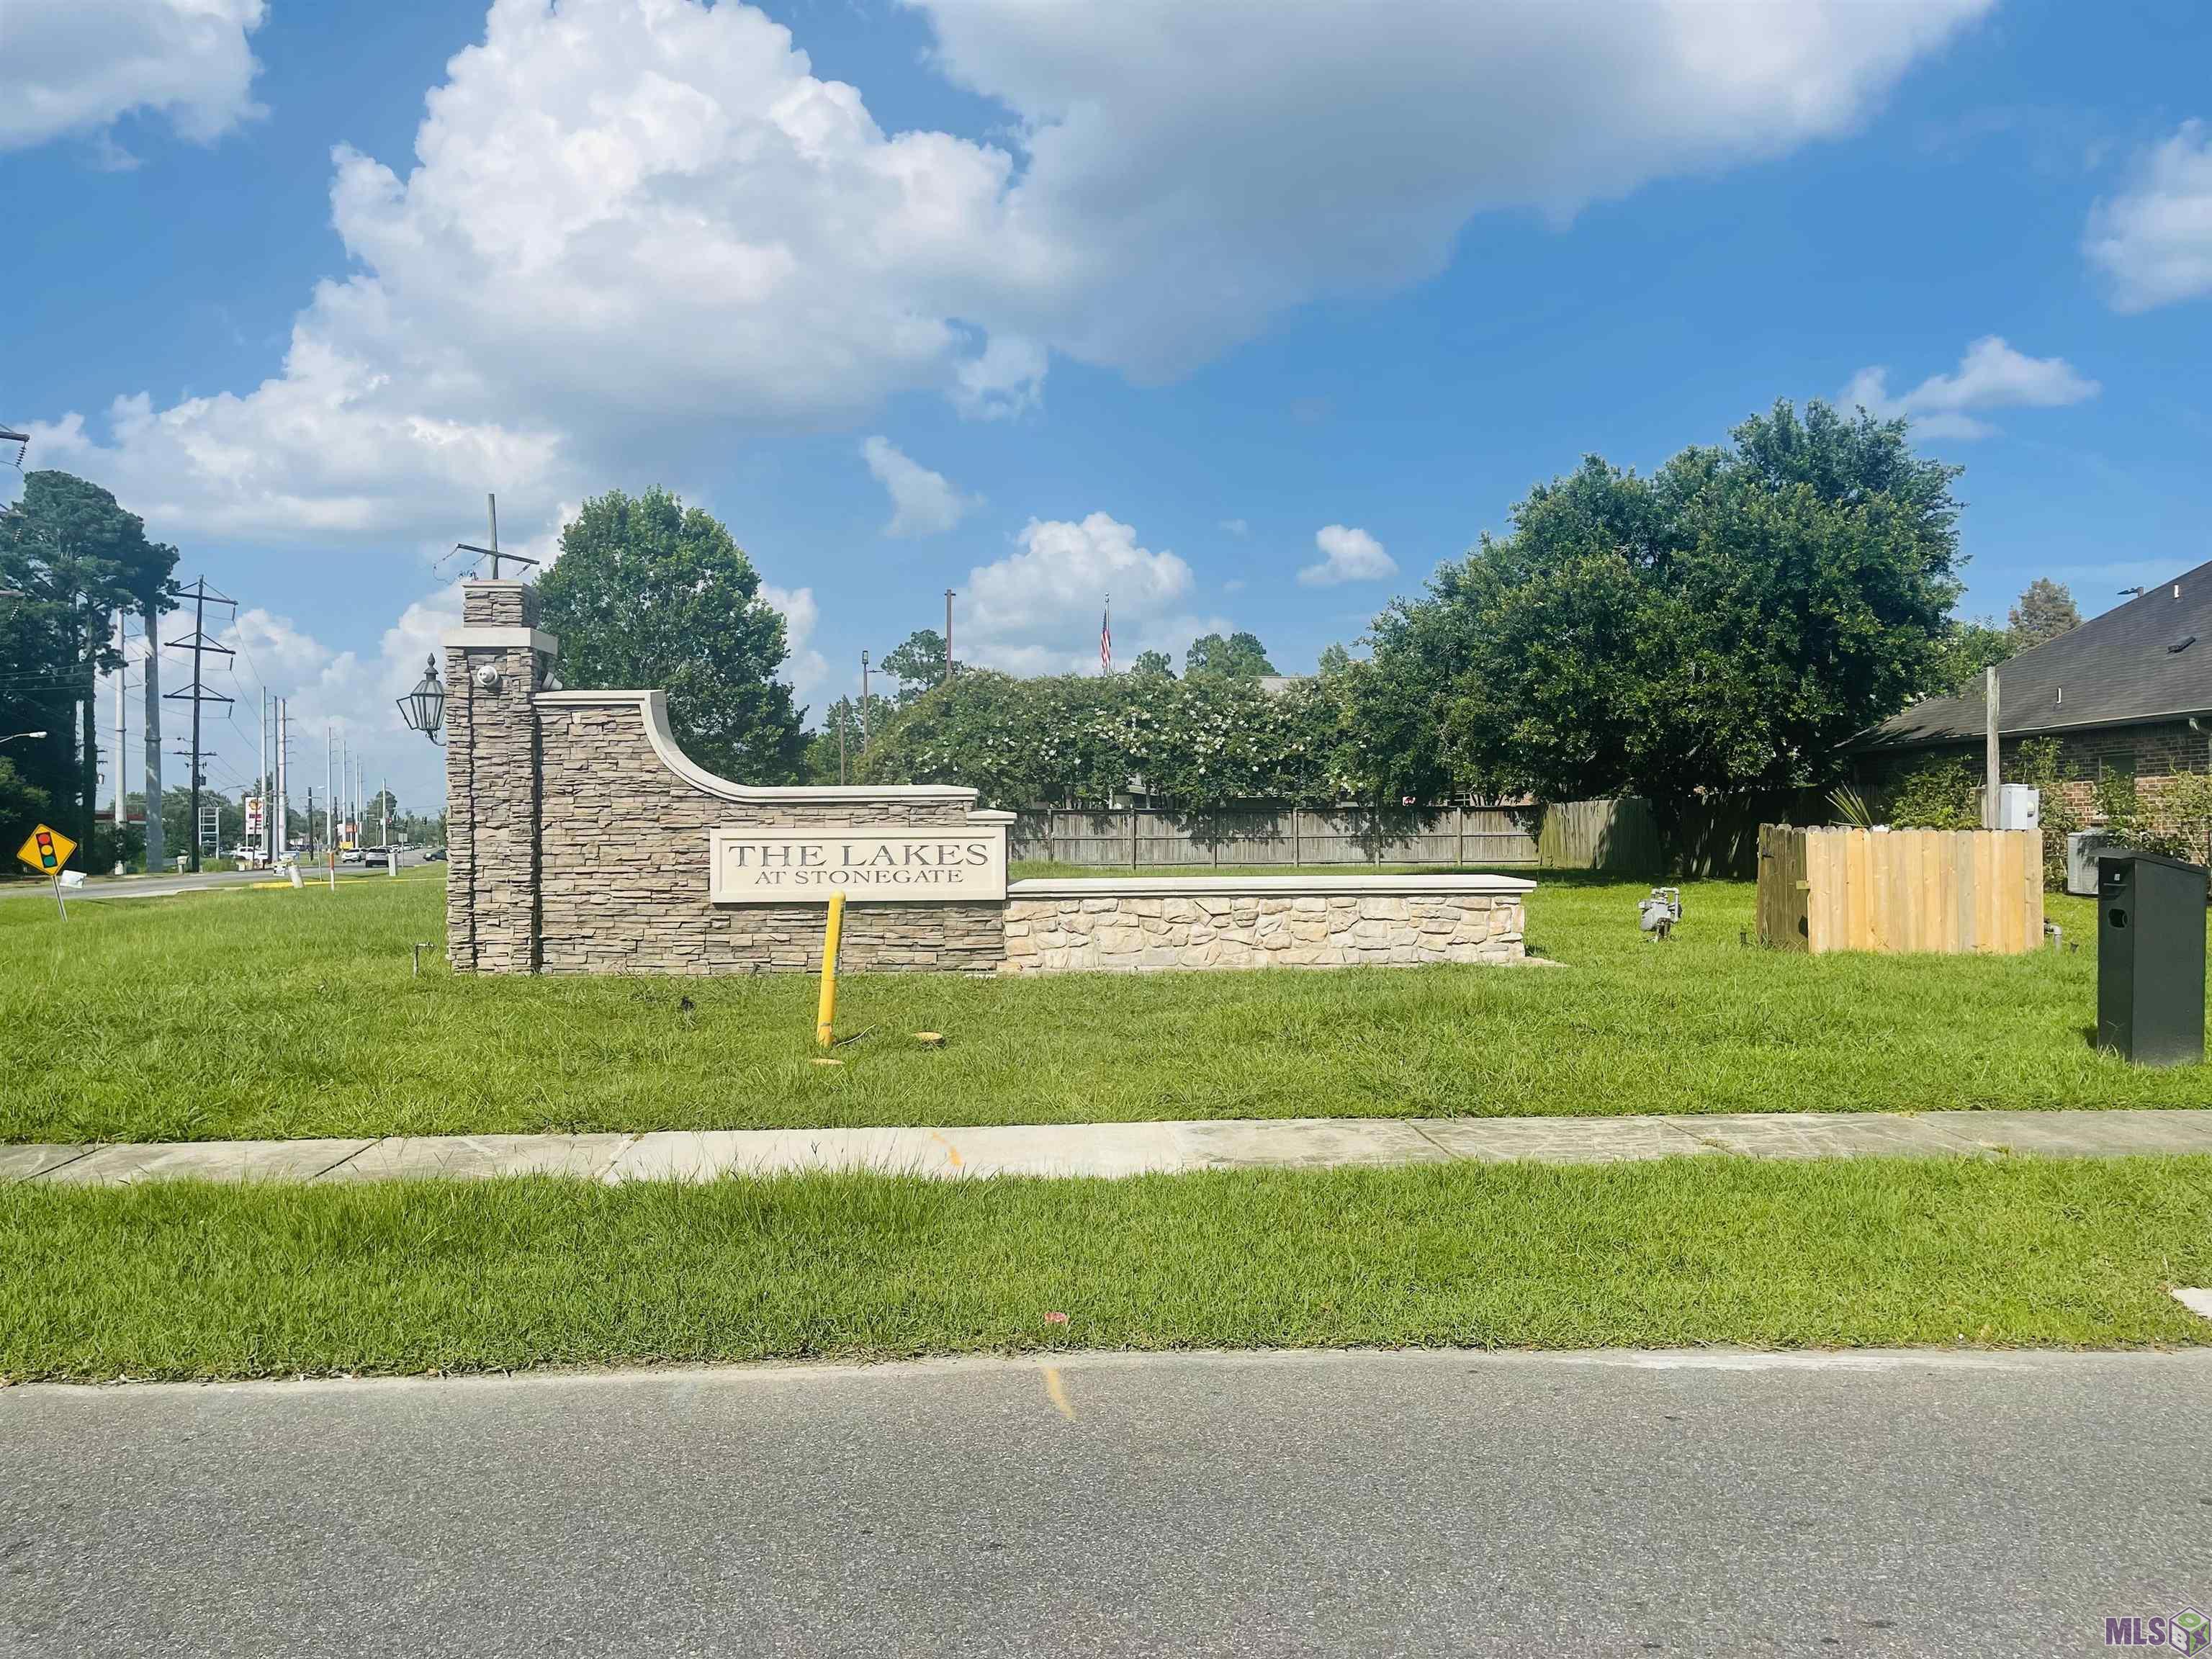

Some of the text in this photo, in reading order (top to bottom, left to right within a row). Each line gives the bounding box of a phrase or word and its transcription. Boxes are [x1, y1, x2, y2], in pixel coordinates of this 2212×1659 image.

[729, 844, 989, 867] THE LAKES
[754, 870, 963, 885] AT STONEGATE
